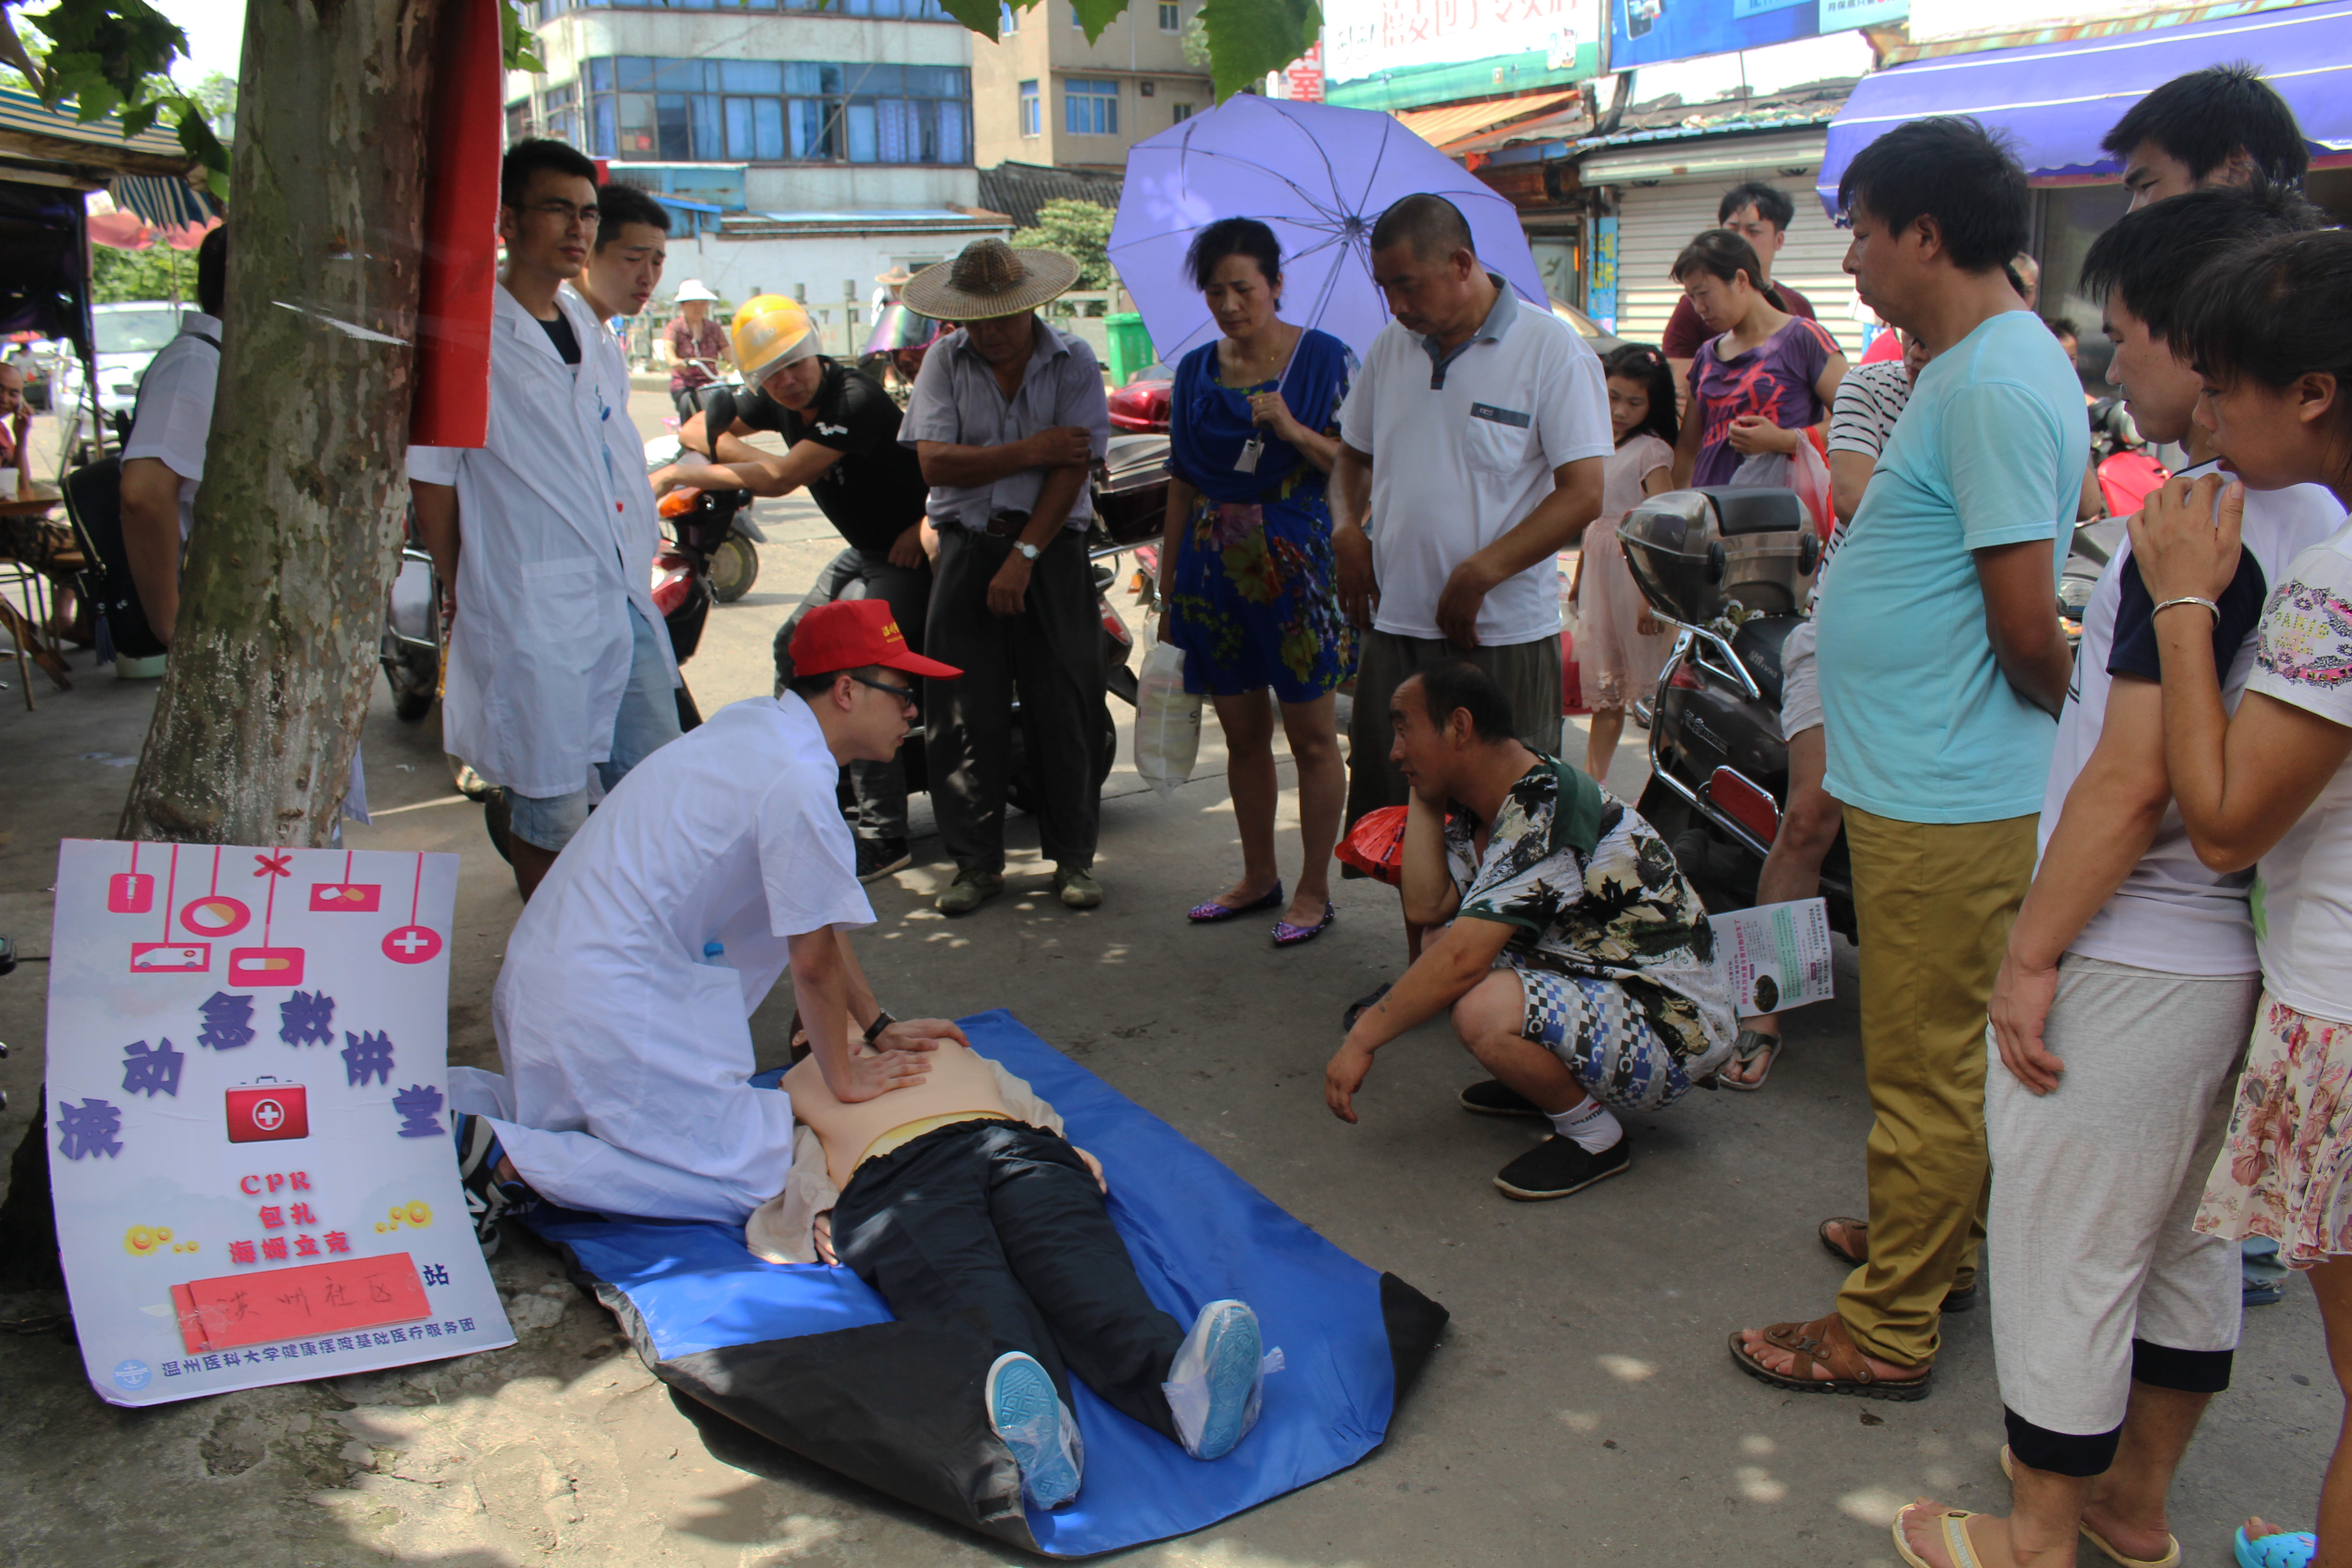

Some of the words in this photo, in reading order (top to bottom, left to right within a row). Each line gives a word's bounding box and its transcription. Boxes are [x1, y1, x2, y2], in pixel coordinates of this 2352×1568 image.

[57, 990, 446, 1160] 流动急救讲堂
[240, 1171, 311, 1195] CPR
[258, 1201, 317, 1230] 包扎
[229, 1230, 351, 1264] 海姆立克
[423, 1263, 450, 1287] 站
[162, 1317, 476, 1378] 温州医科大学健康摆渡基础医疗服务团
